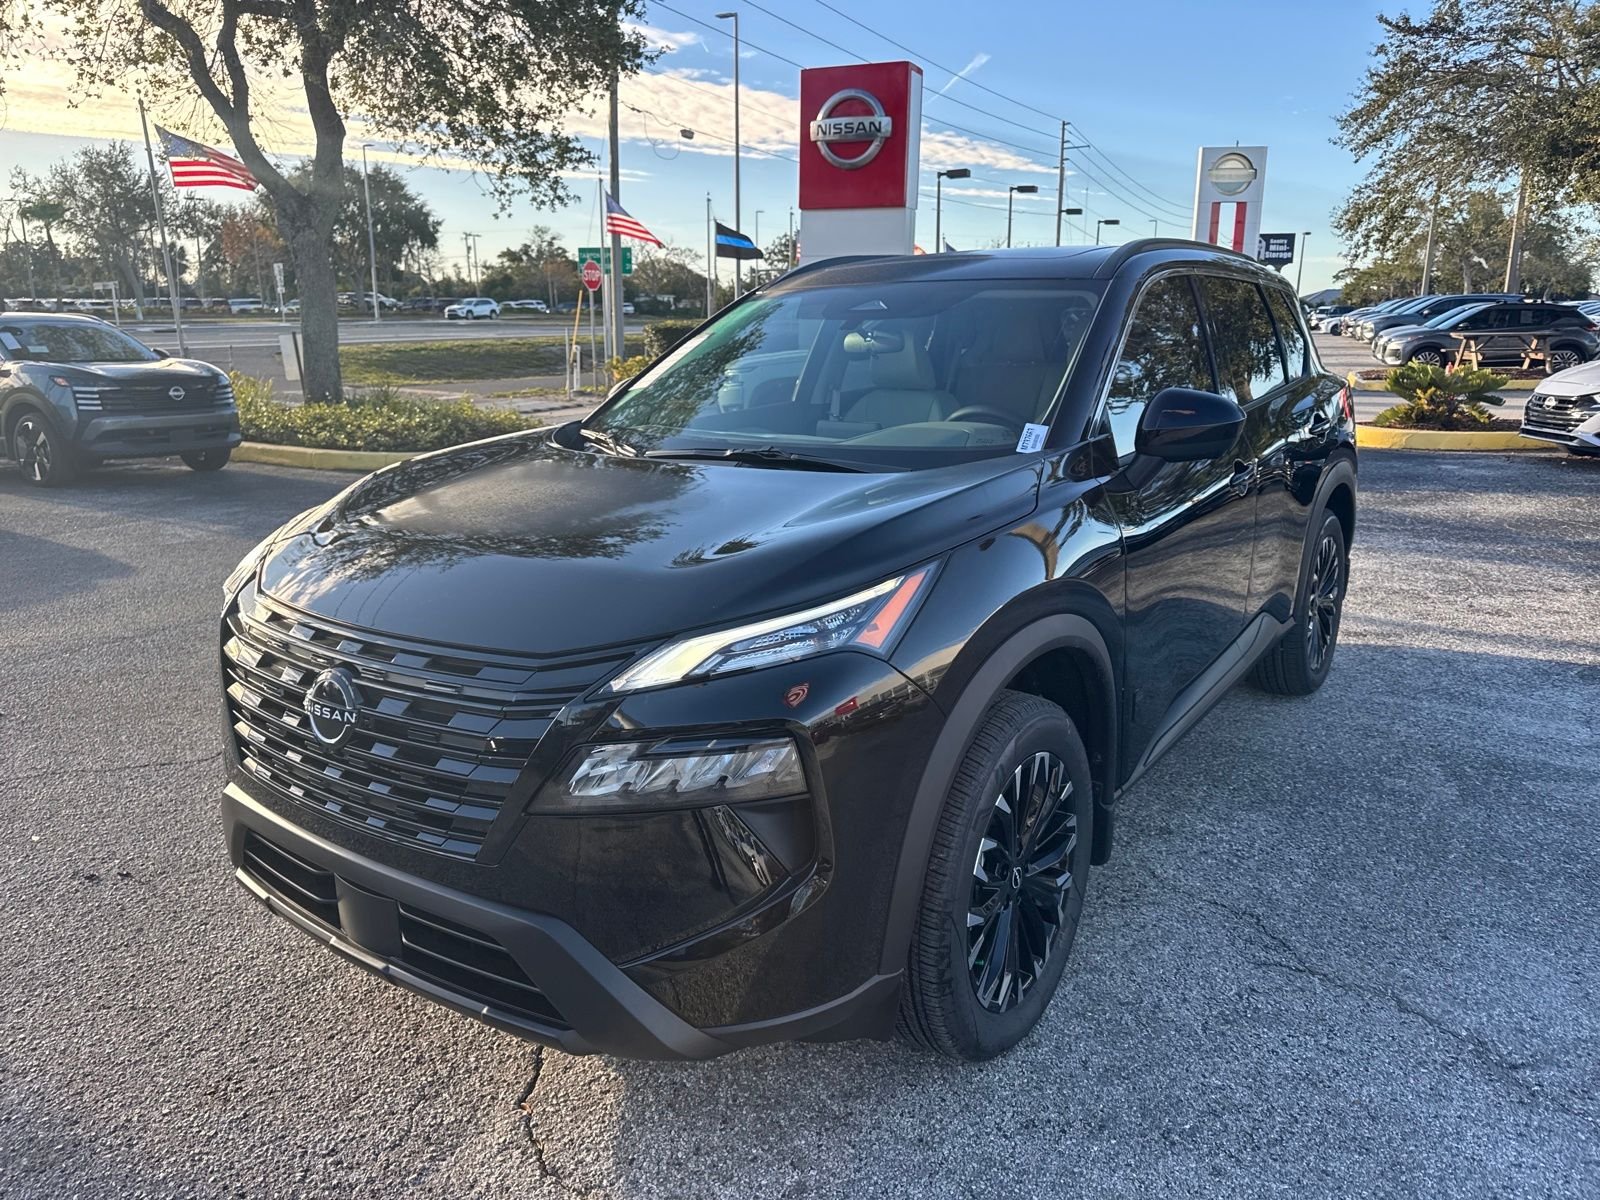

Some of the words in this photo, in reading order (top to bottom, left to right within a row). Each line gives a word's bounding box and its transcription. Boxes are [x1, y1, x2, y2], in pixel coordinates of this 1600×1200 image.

[816, 121, 882, 137] NISSAN
[1265, 251, 1292, 259] Storage
[584, 269, 601, 282] STOP
